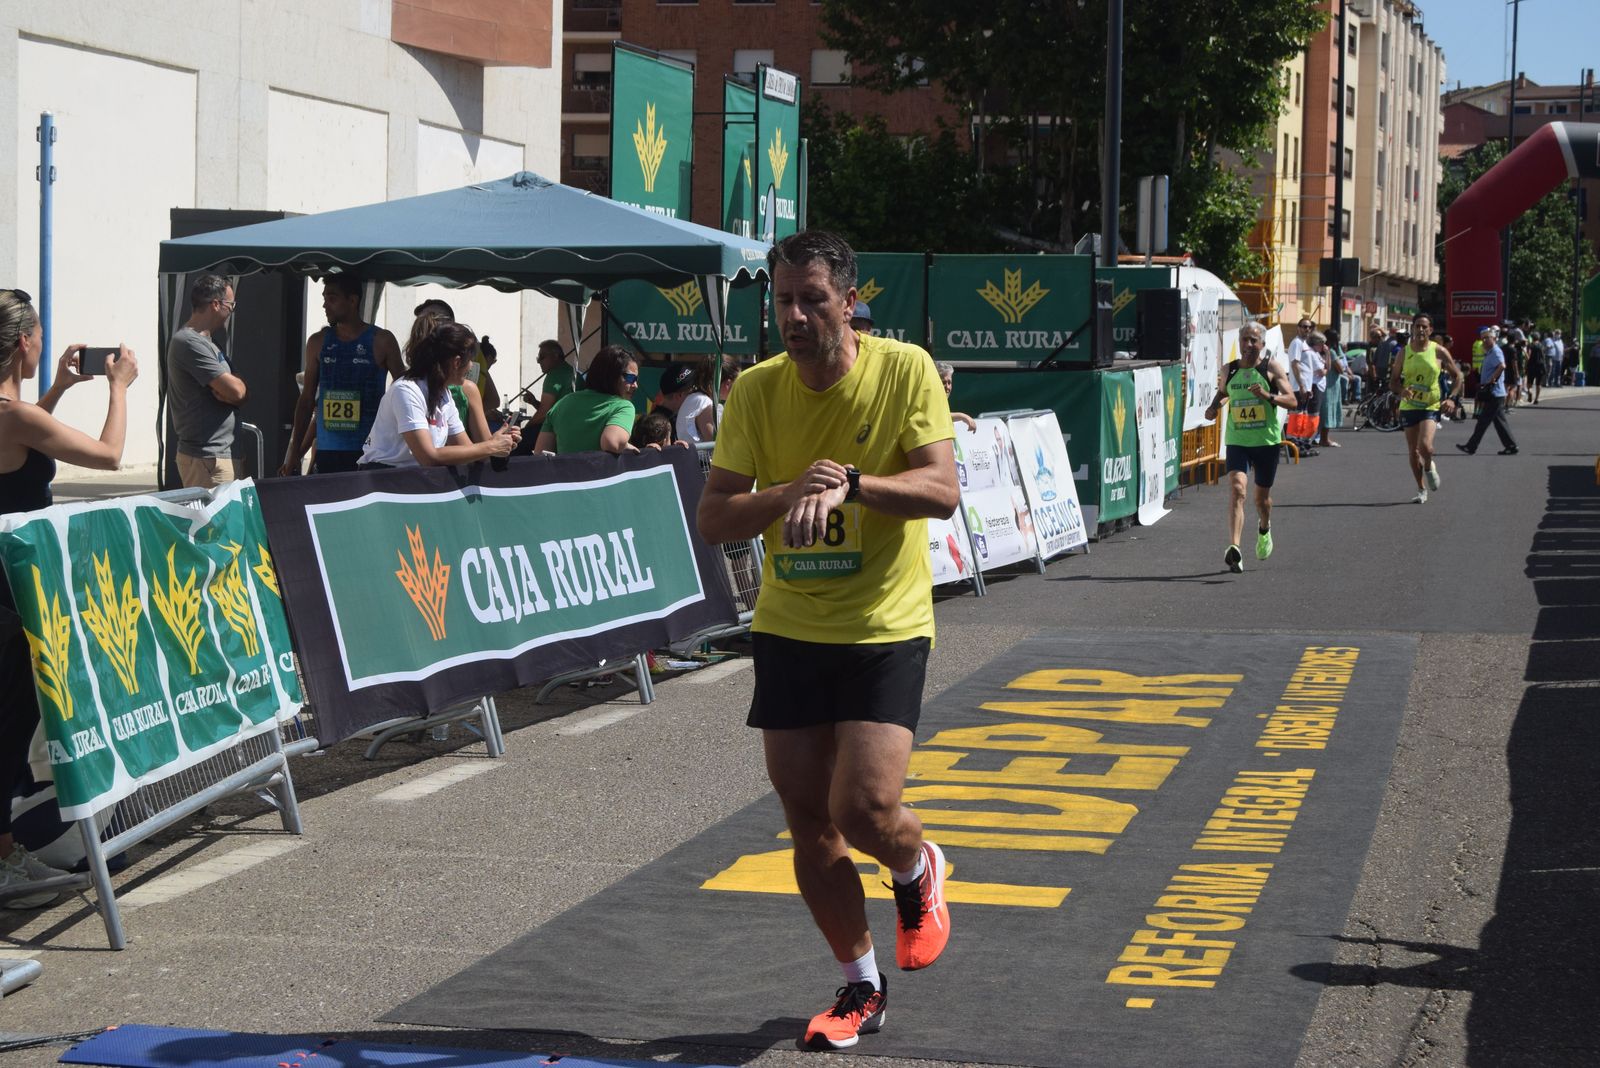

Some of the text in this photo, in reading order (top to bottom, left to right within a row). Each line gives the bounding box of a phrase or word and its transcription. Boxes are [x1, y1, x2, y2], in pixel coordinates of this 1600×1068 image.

[623, 322, 748, 342] CAJA RUAL
[947, 330, 1080, 350] CAJA RURAL
[326, 402, 353, 418] 128
[1239, 407, 1257, 420] 44
[1033, 497, 1081, 540] OCEANIC
[460, 527, 655, 624] CAJA RURAL
[794, 559, 856, 571] CAJA RURAL
[1255, 646, 1361, 750] DISEÑO INTERIORES
[136, 700, 169, 734] RURAL
[1104, 768, 1316, 988] REFORMA INTEGRAL
